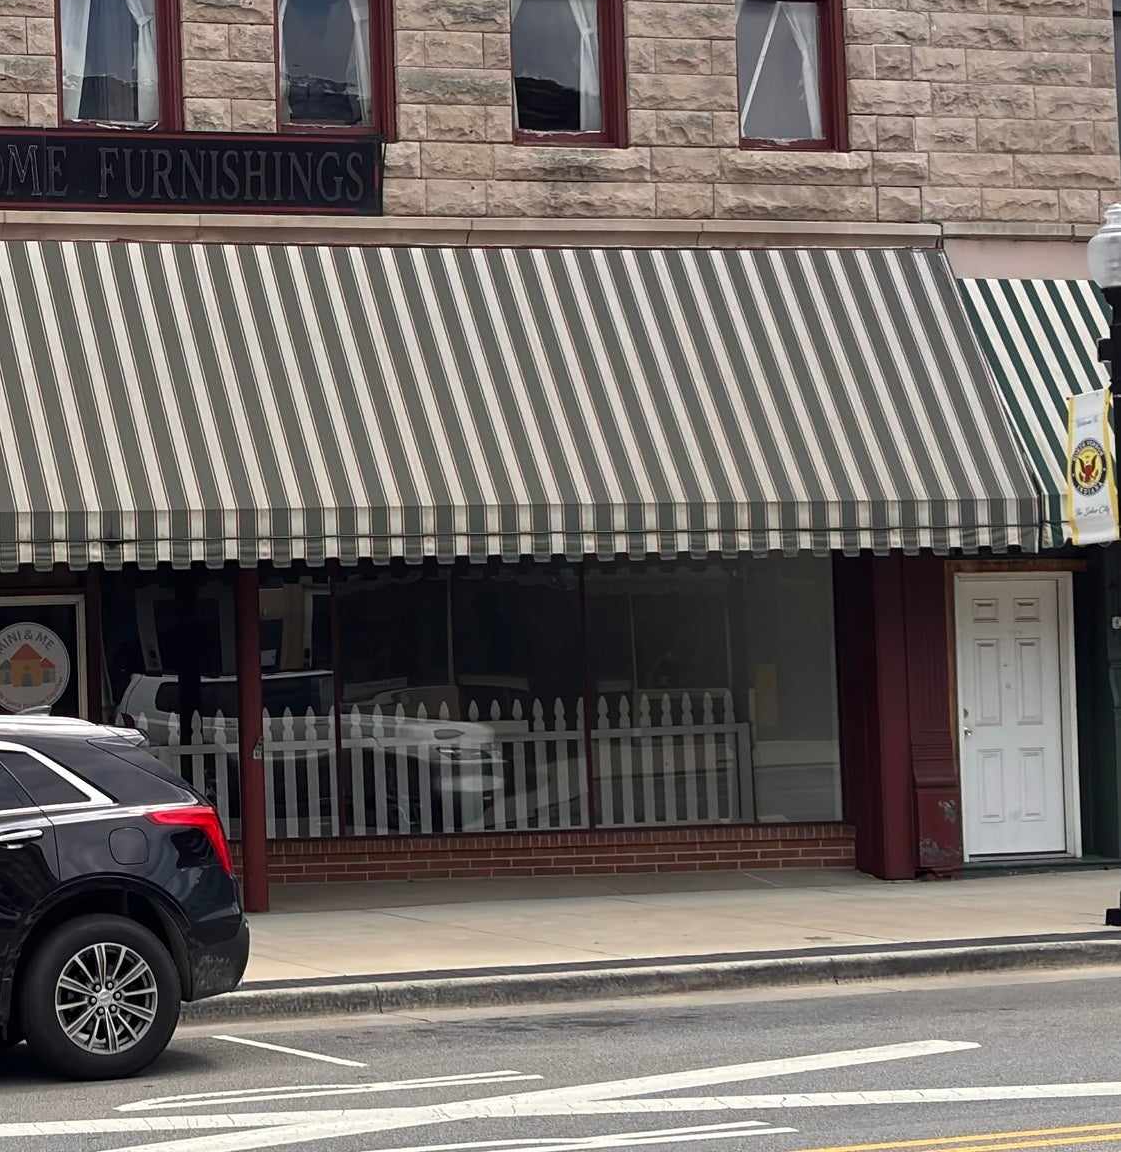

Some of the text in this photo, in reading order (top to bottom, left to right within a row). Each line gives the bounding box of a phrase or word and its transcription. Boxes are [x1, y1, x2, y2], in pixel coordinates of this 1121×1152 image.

[97, 146, 365, 202] FURNISHINGS
[23, 629, 33, 640] &
[35, 631, 55, 651] ME
